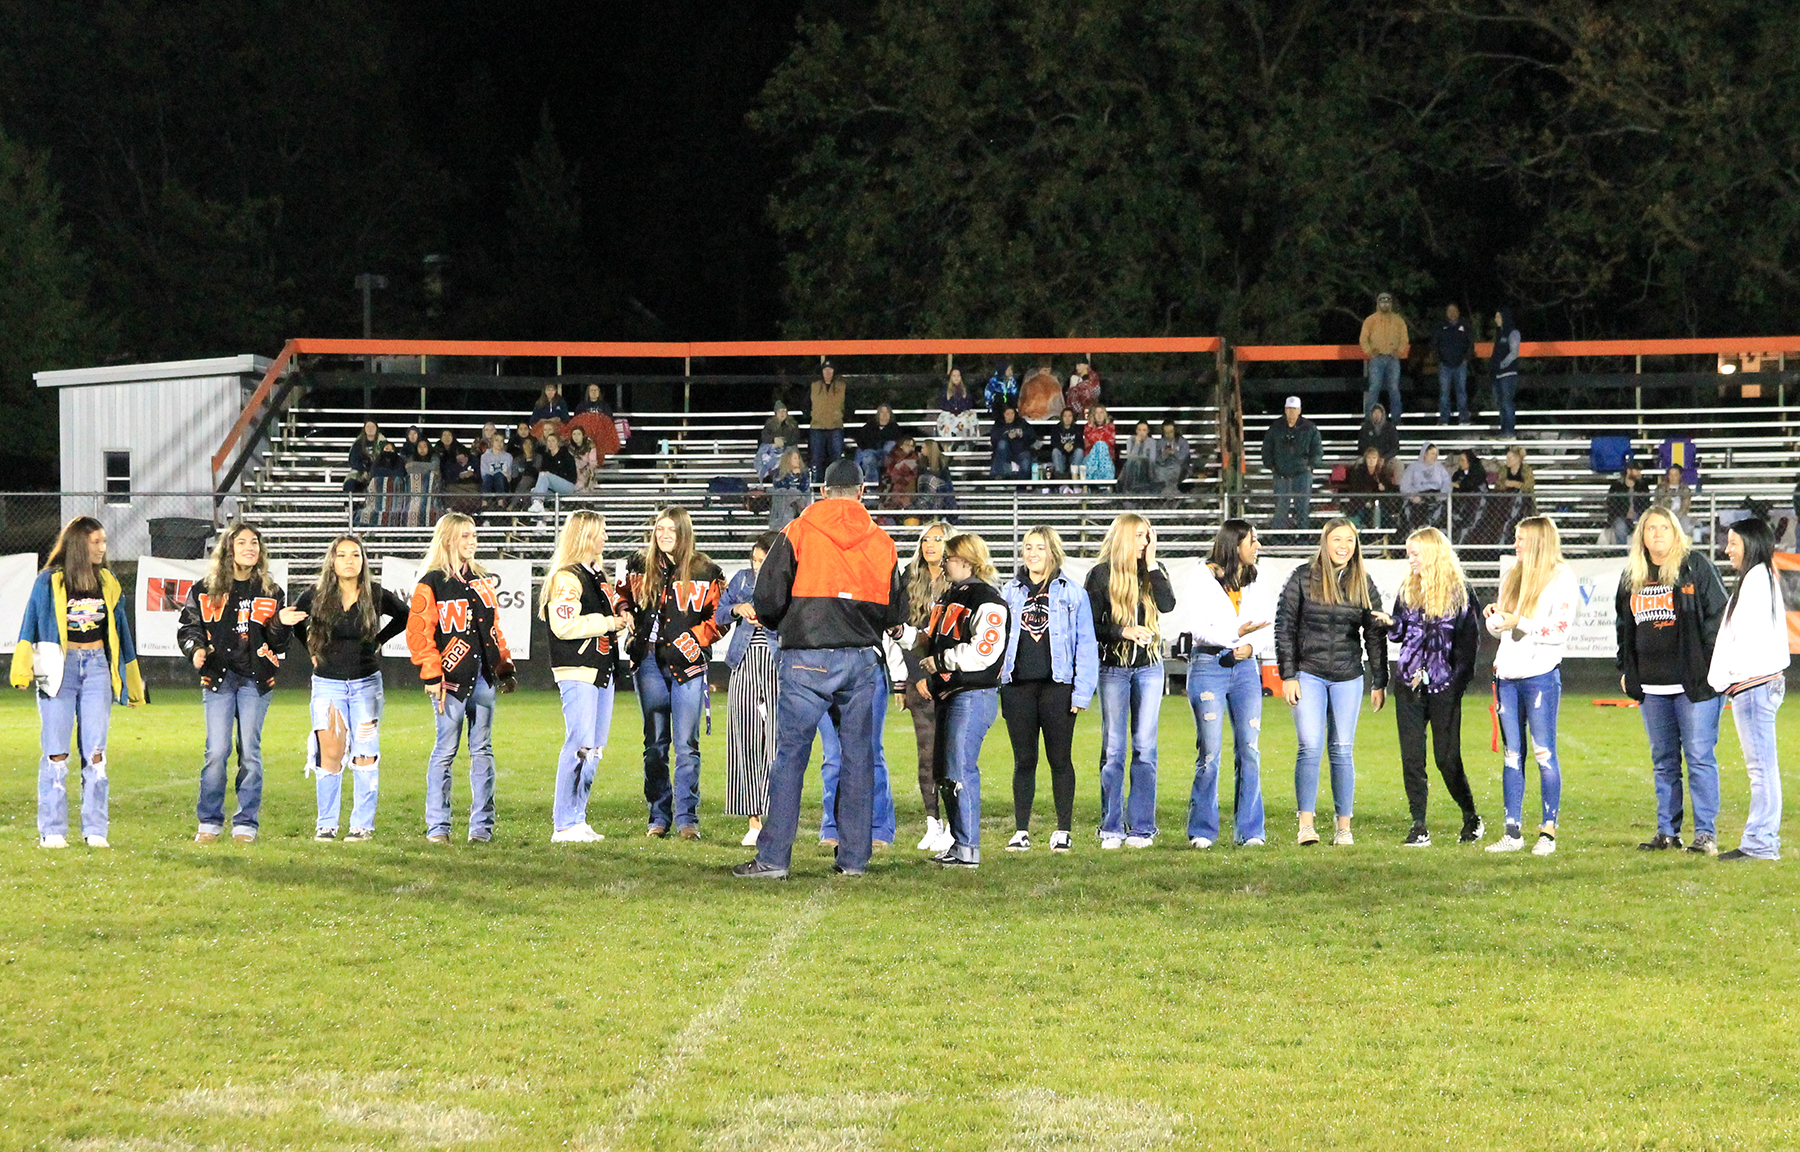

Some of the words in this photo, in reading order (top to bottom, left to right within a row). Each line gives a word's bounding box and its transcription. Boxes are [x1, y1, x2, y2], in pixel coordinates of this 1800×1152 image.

[198, 593, 229, 622] W
[497, 591, 525, 609] GS
[672, 580, 710, 612] W
[1630, 592, 1675, 616] VIKING
[437, 599, 469, 634] W
[556, 605, 574, 619] CTR
[1580, 634, 1609, 643] Support
[441, 639, 471, 672] 2021
